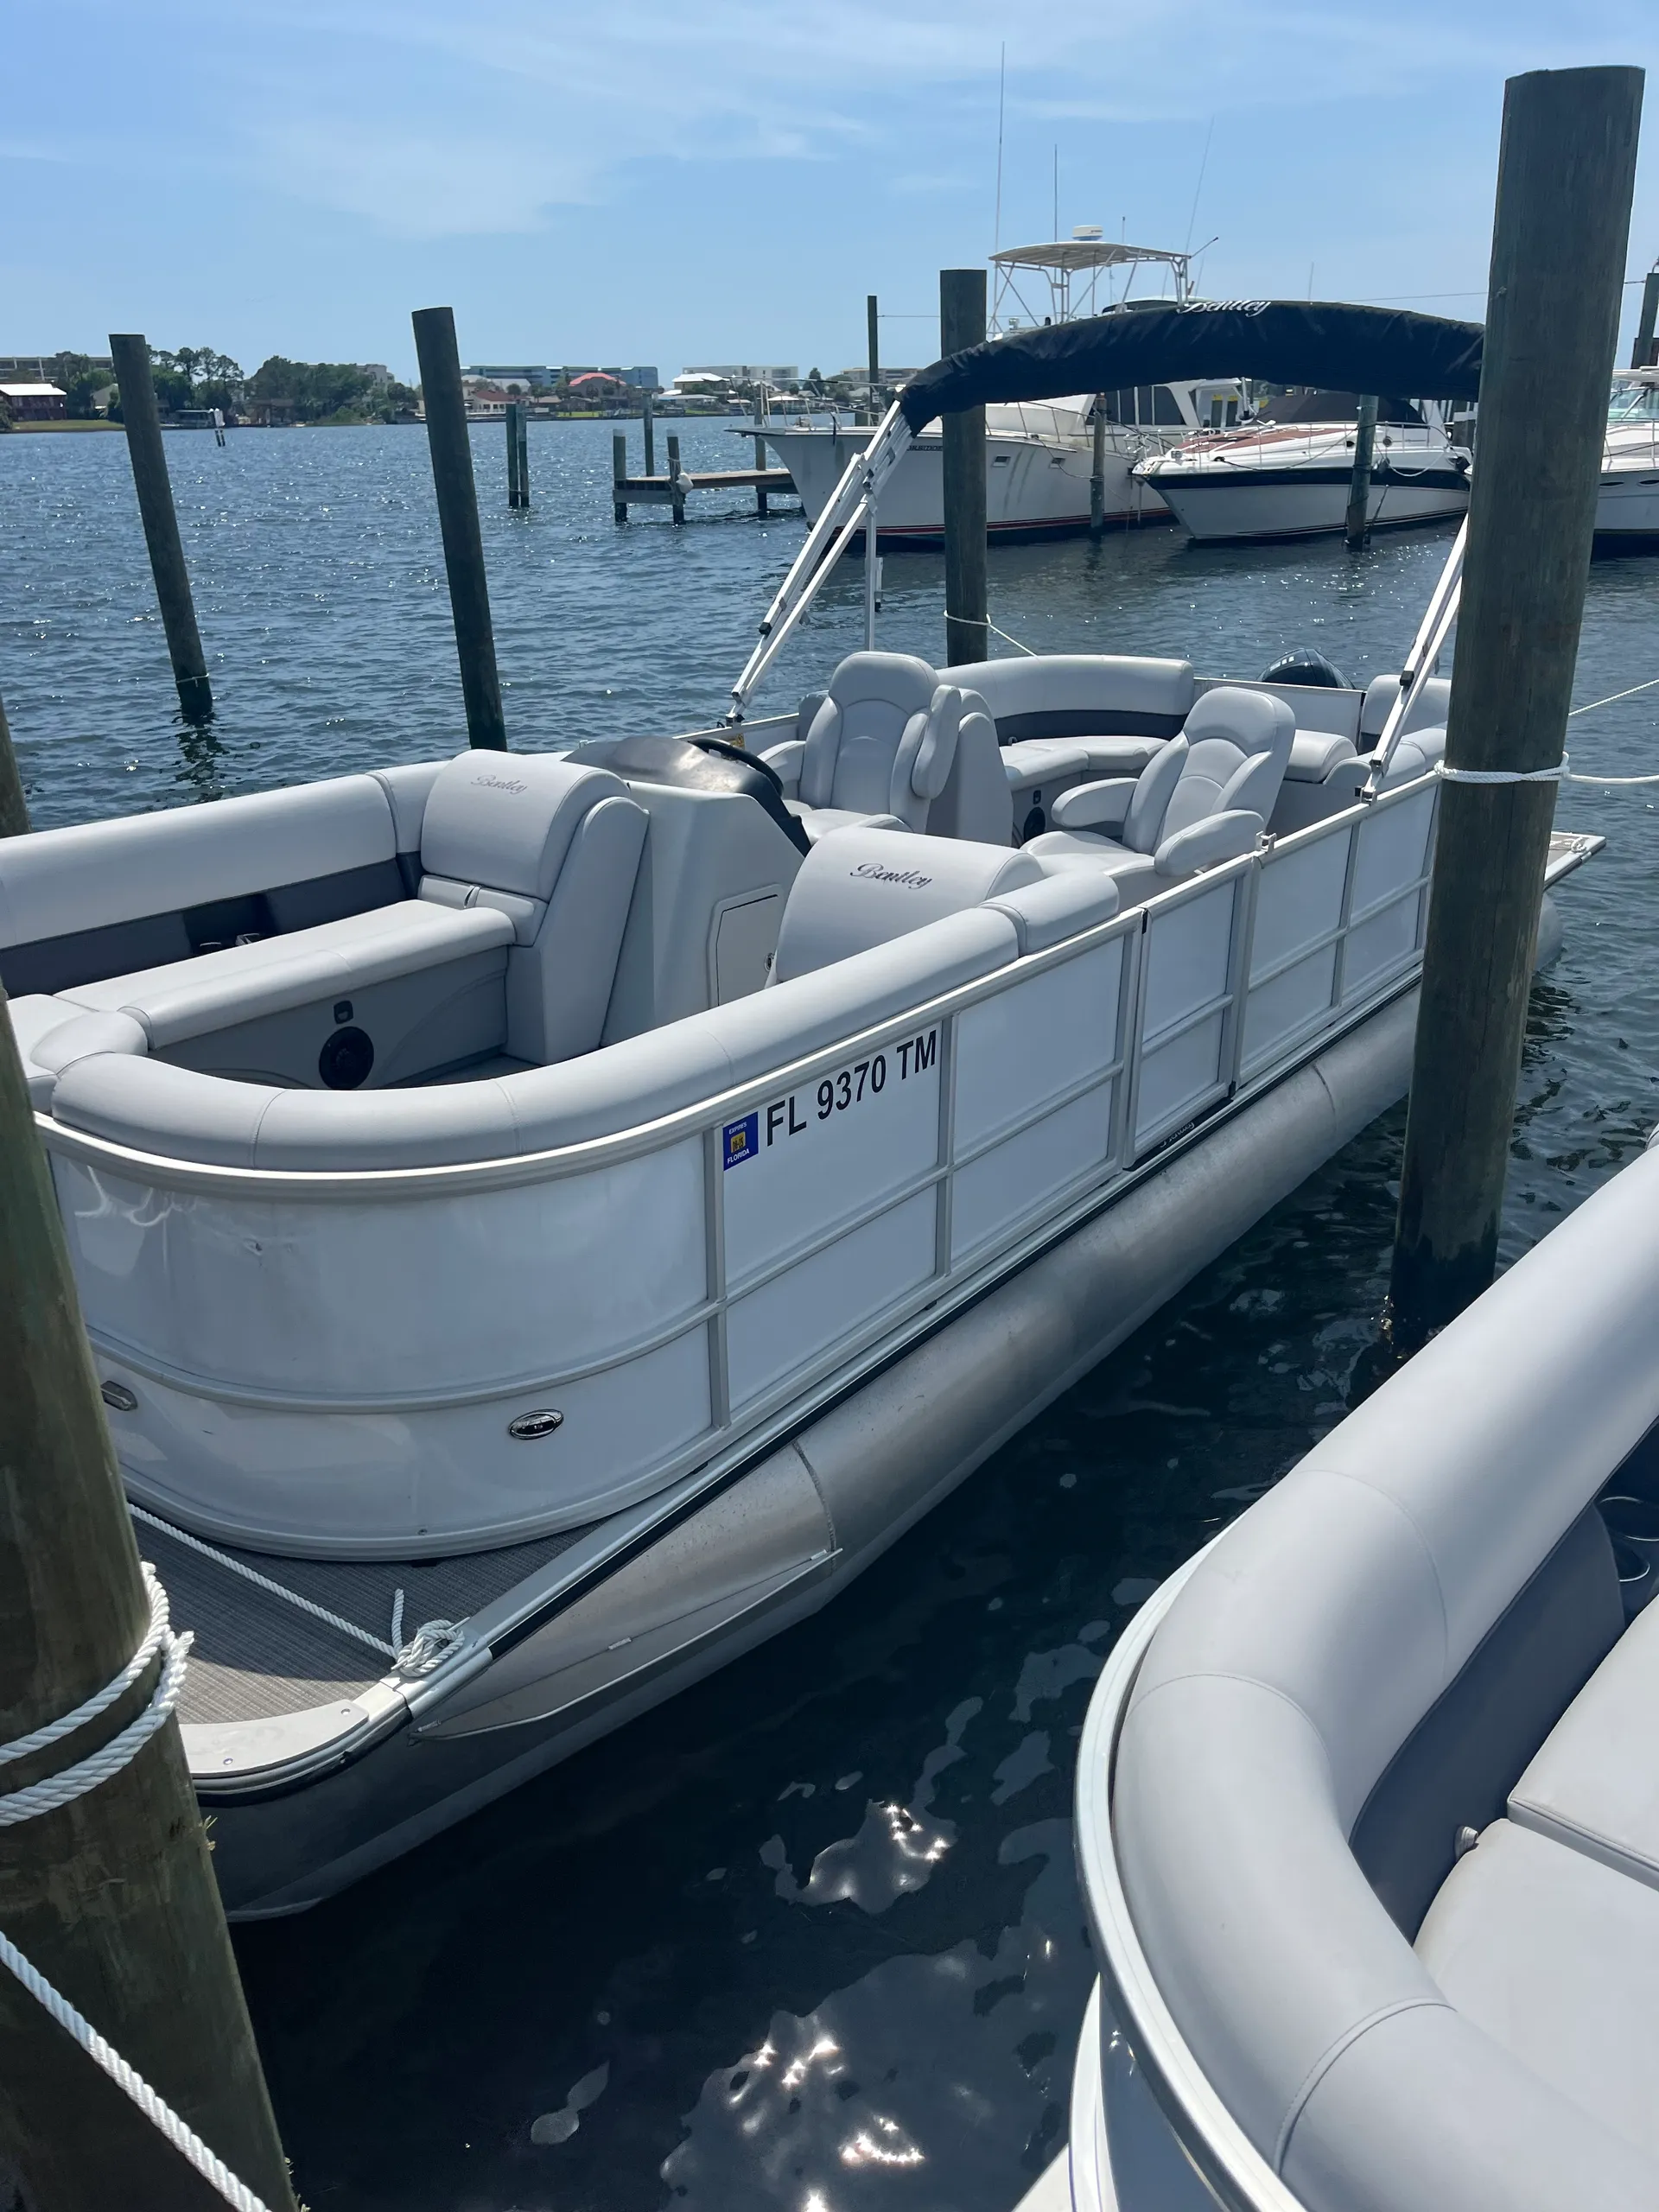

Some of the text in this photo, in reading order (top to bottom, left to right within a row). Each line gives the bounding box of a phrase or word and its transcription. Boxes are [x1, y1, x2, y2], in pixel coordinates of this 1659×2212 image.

[470, 774, 528, 795] Bentley
[849, 862, 932, 890] Bentley
[766, 1029, 937, 1147] FL 9370 TM
[728, 1122, 747, 1135] EXPIRES
[727, 1148, 750, 1165] FLORIDA
